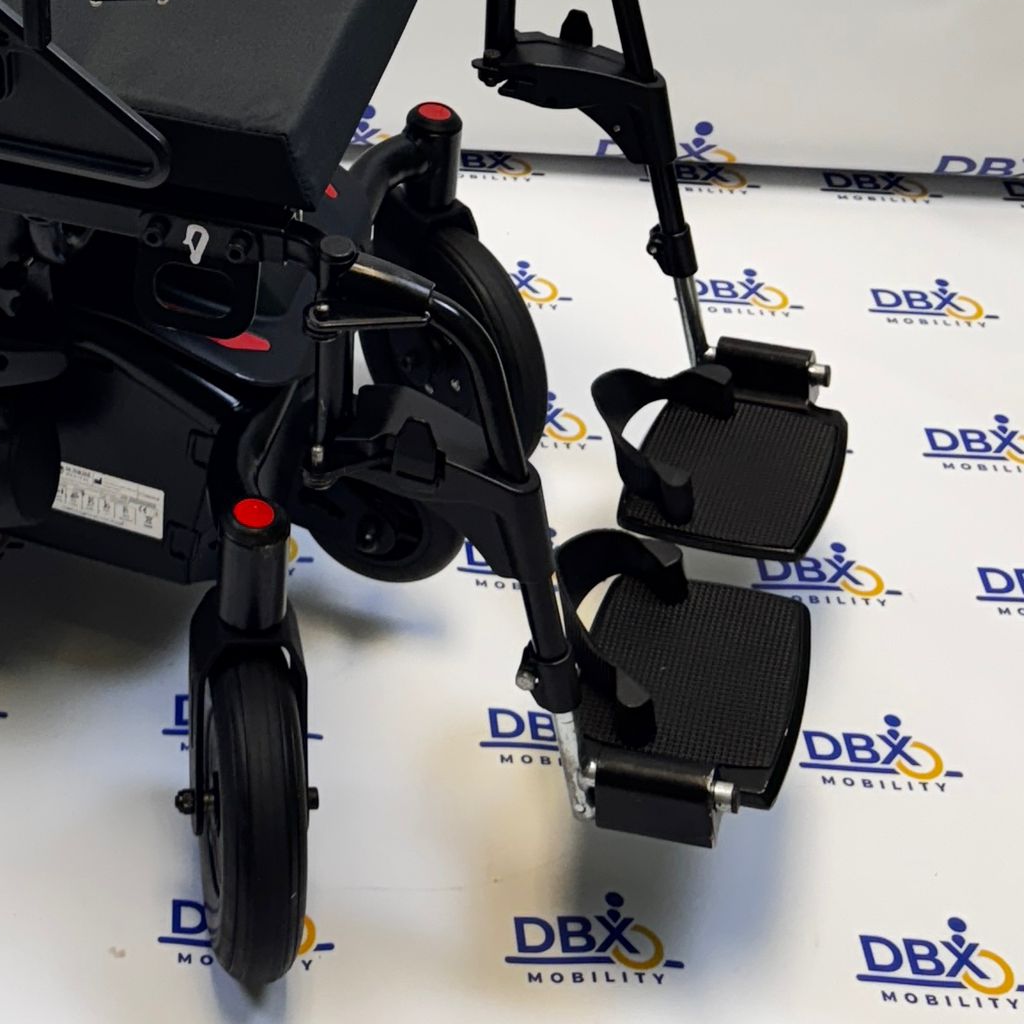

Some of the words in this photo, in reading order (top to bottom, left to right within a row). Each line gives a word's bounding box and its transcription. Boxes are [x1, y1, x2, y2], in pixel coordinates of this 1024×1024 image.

[462, 153, 514, 171] BX
[935, 155, 1024, 177] DB
[677, 164, 729, 183] BX
[821, 172, 910, 192] DBX
[685, 187, 747, 195] BILITY
[837, 195, 930, 204] MOBILITY
[871, 289, 964, 312] DBX
[707, 306, 790, 318] OBILITY
[887, 318, 985, 328] MOBILITY
[924, 427, 1023, 455] DBX
[942, 462, 1024, 474] MOBILI
[755, 557, 860, 585] DBX
[791, 594, 888, 608] OBILITY
[488, 708, 557, 741] DB
[802, 730, 920, 766] DBX
[821, 776, 946, 792] MOBILITY
[514, 915, 641, 954] DBX
[859, 935, 990, 979] DBX
[528, 971, 664, 985] MOBILITY
[881, 990, 1018, 1009] MOBILITY
